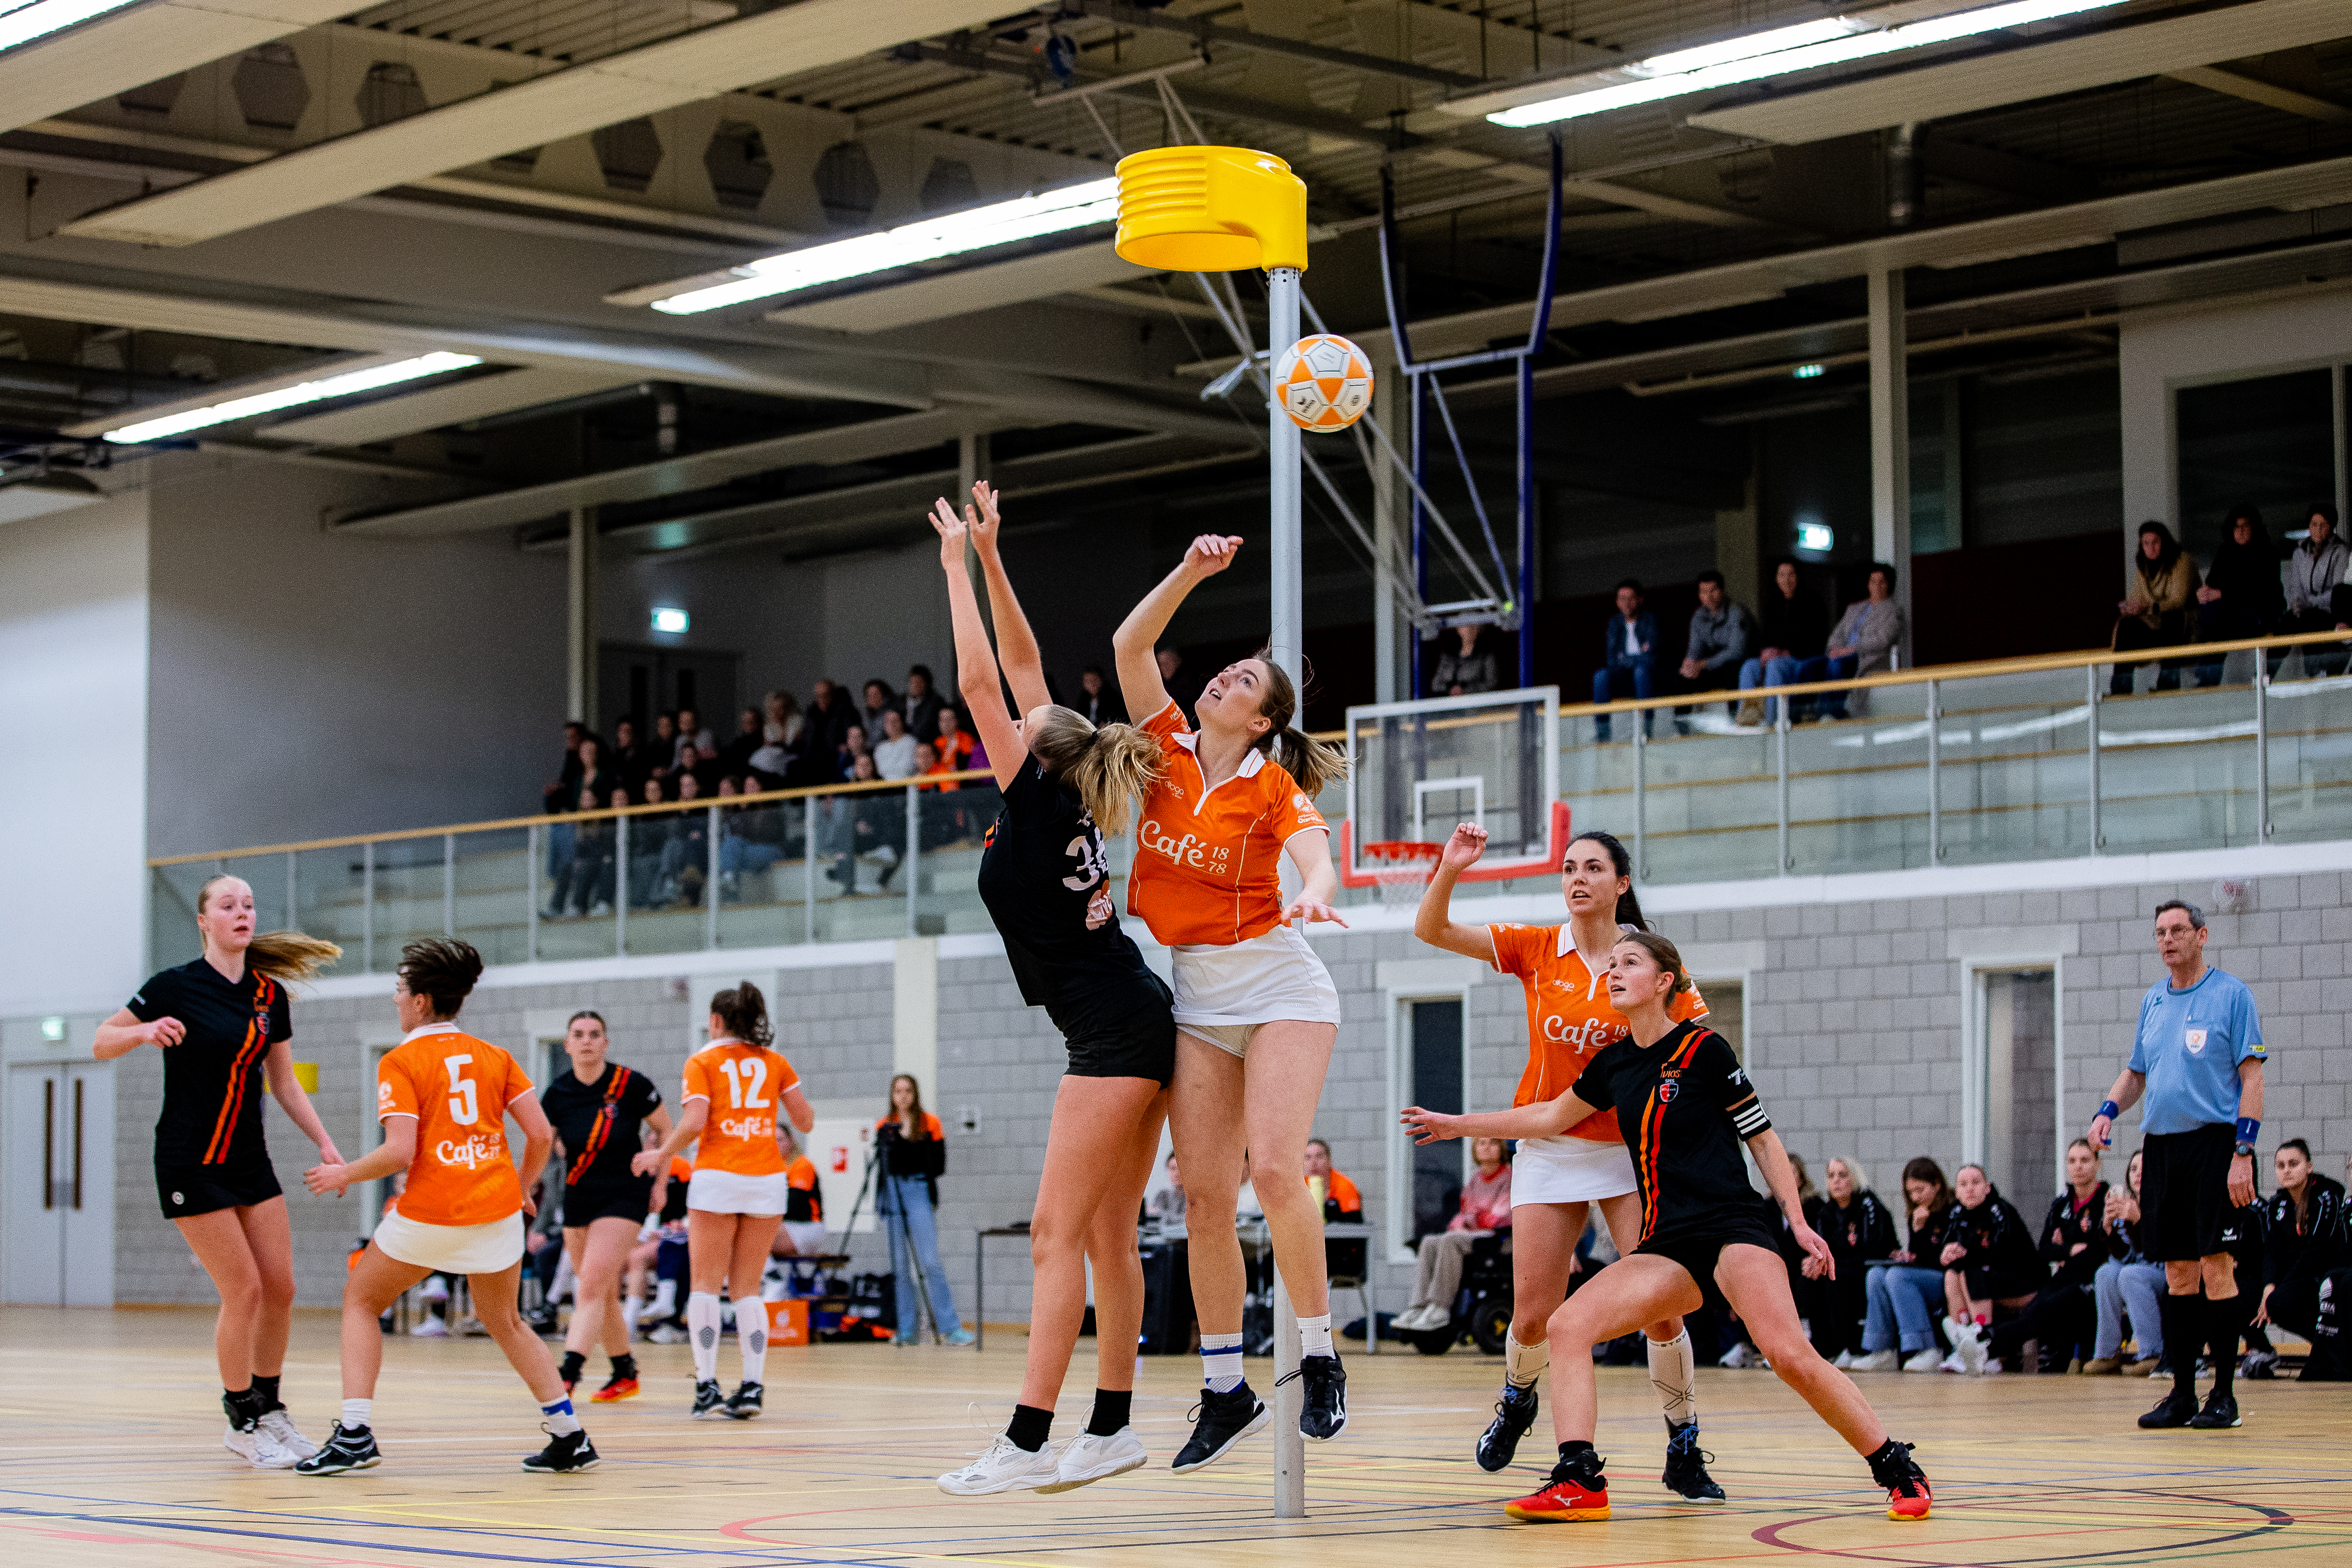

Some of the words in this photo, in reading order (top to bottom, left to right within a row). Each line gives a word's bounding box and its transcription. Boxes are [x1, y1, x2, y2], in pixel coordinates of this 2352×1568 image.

[1141, 820, 1207, 868] Café
[1212, 846, 1229, 860] 18
[1209, 861, 1227, 874] 78
[1544, 1015, 1609, 1054] Café
[1614, 1024, 1628, 1037] 18
[444, 1054, 478, 1125] 5
[719, 1057, 770, 1108] 12
[720, 1116, 761, 1142] Café
[436, 1134, 489, 1170] Café
